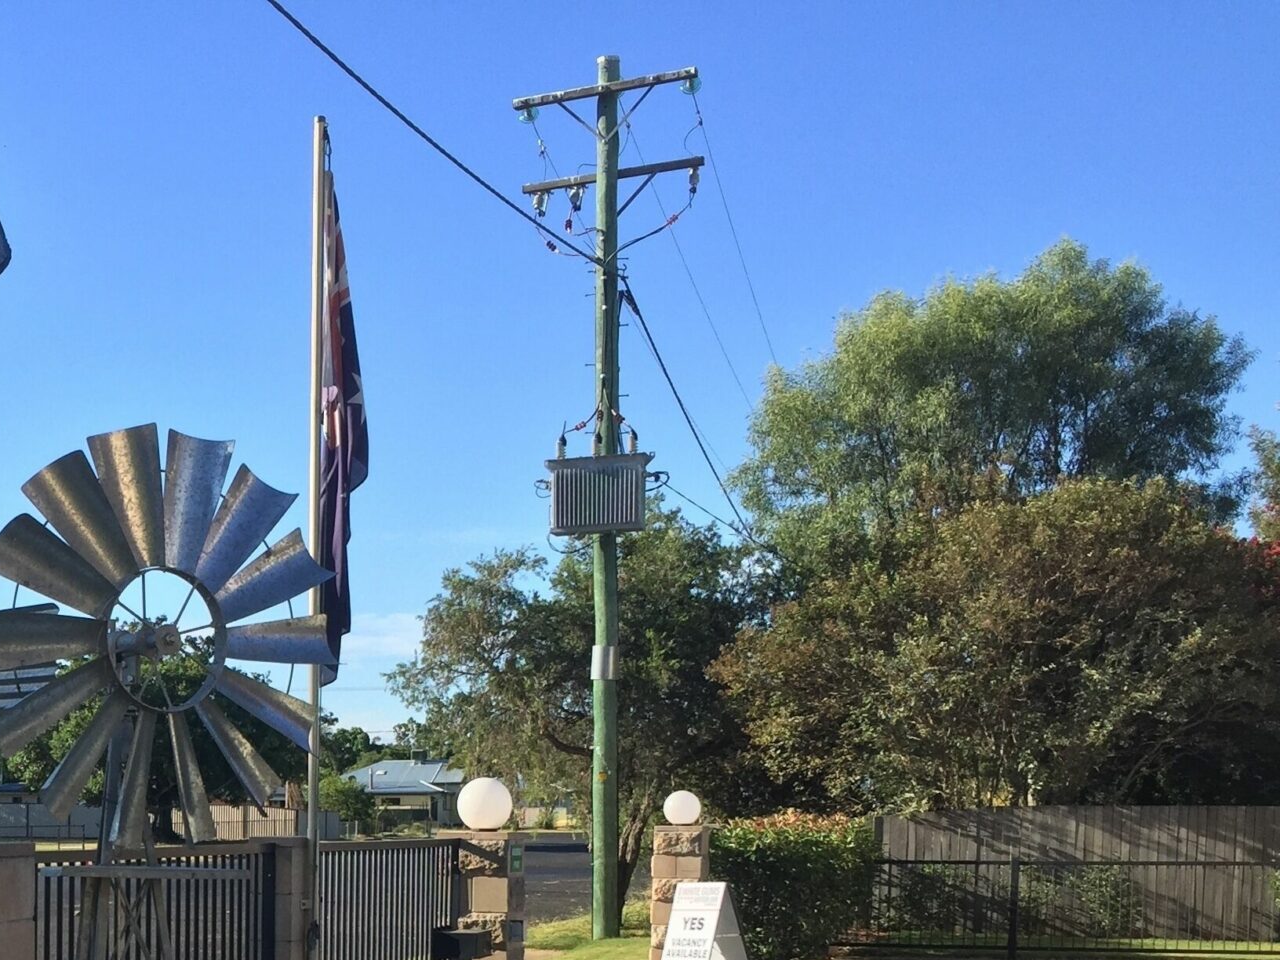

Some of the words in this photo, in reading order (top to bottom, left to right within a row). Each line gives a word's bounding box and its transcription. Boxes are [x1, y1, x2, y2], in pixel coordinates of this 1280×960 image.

[683, 917, 705, 930] YES
[671, 938, 708, 947] VACANCY
[666, 949, 708, 959] AVAILABLE
